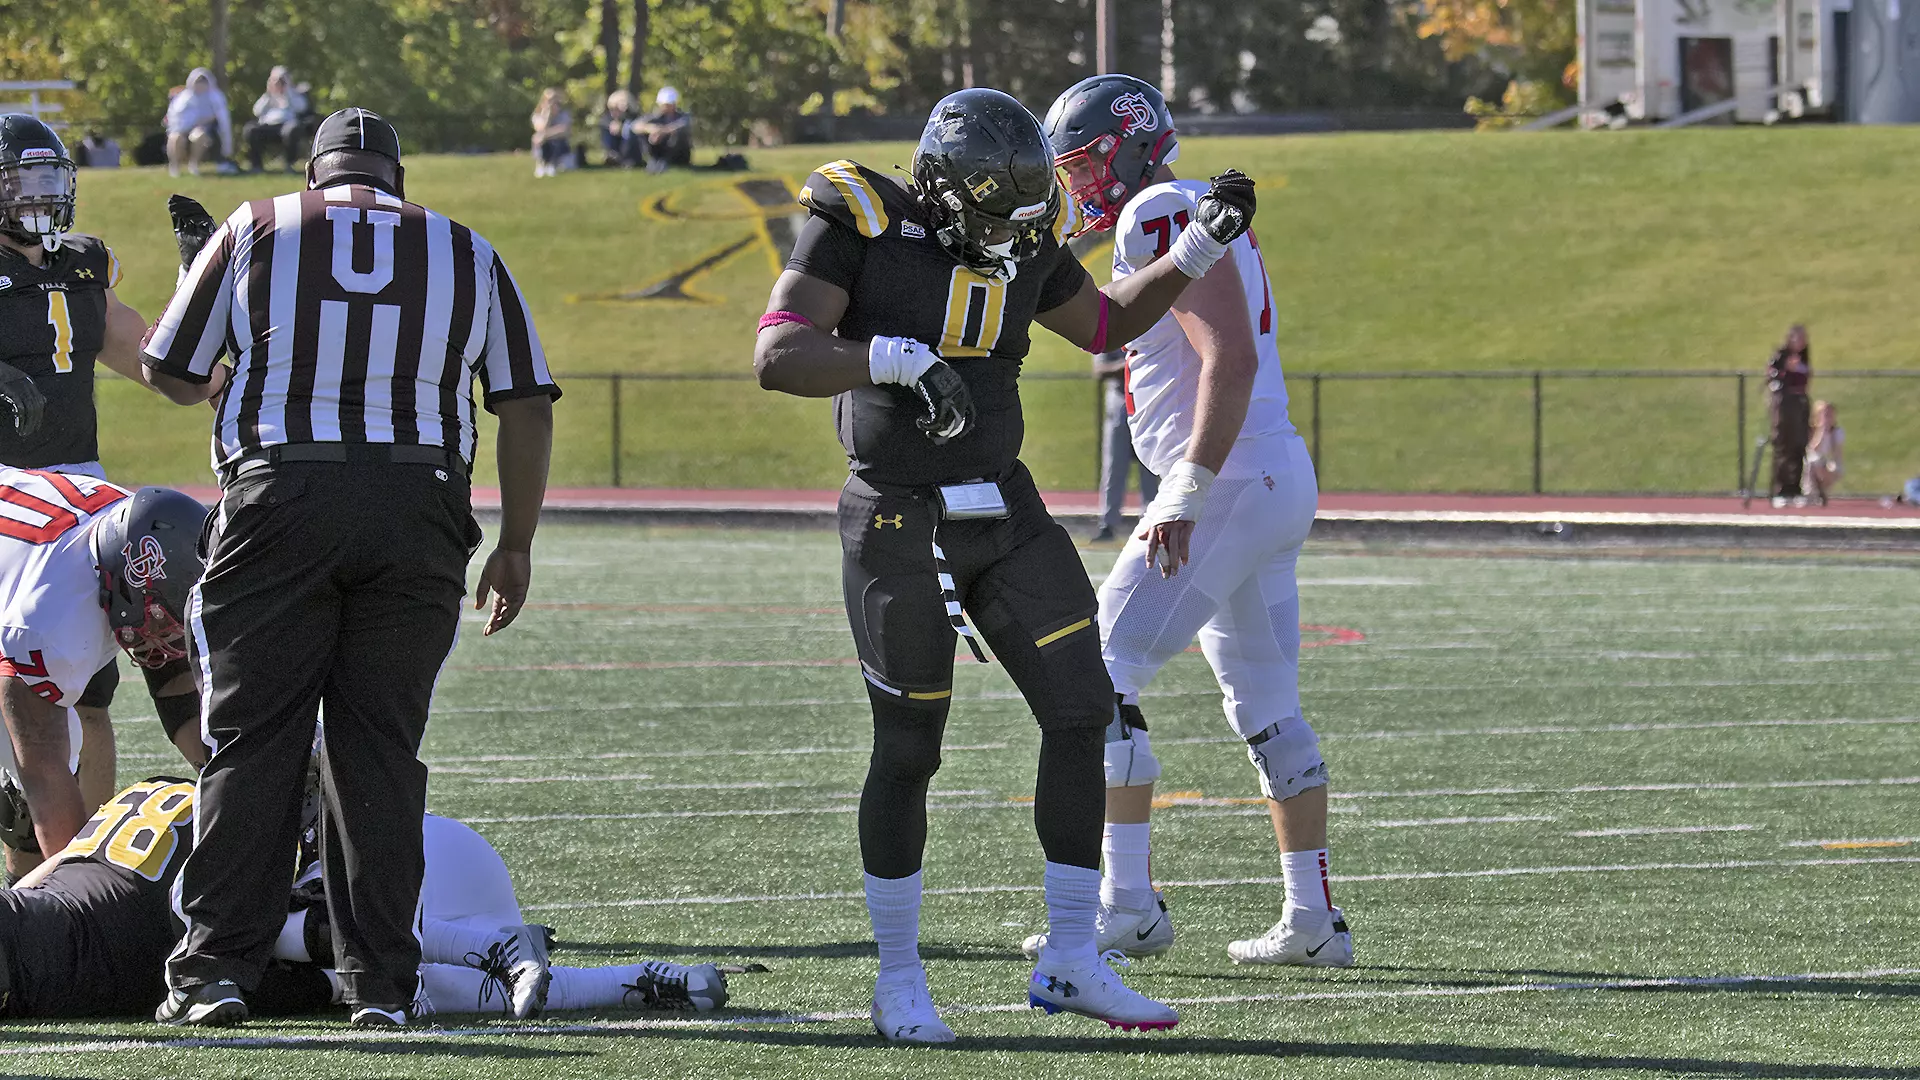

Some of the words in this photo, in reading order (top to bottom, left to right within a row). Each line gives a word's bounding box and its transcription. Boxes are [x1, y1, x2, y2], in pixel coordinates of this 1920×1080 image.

[325, 205, 402, 295] U
[903, 224, 923, 234] PSAC
[48, 291, 74, 374] 1
[937, 264, 1007, 358] 0
[63, 780, 196, 883] 58
